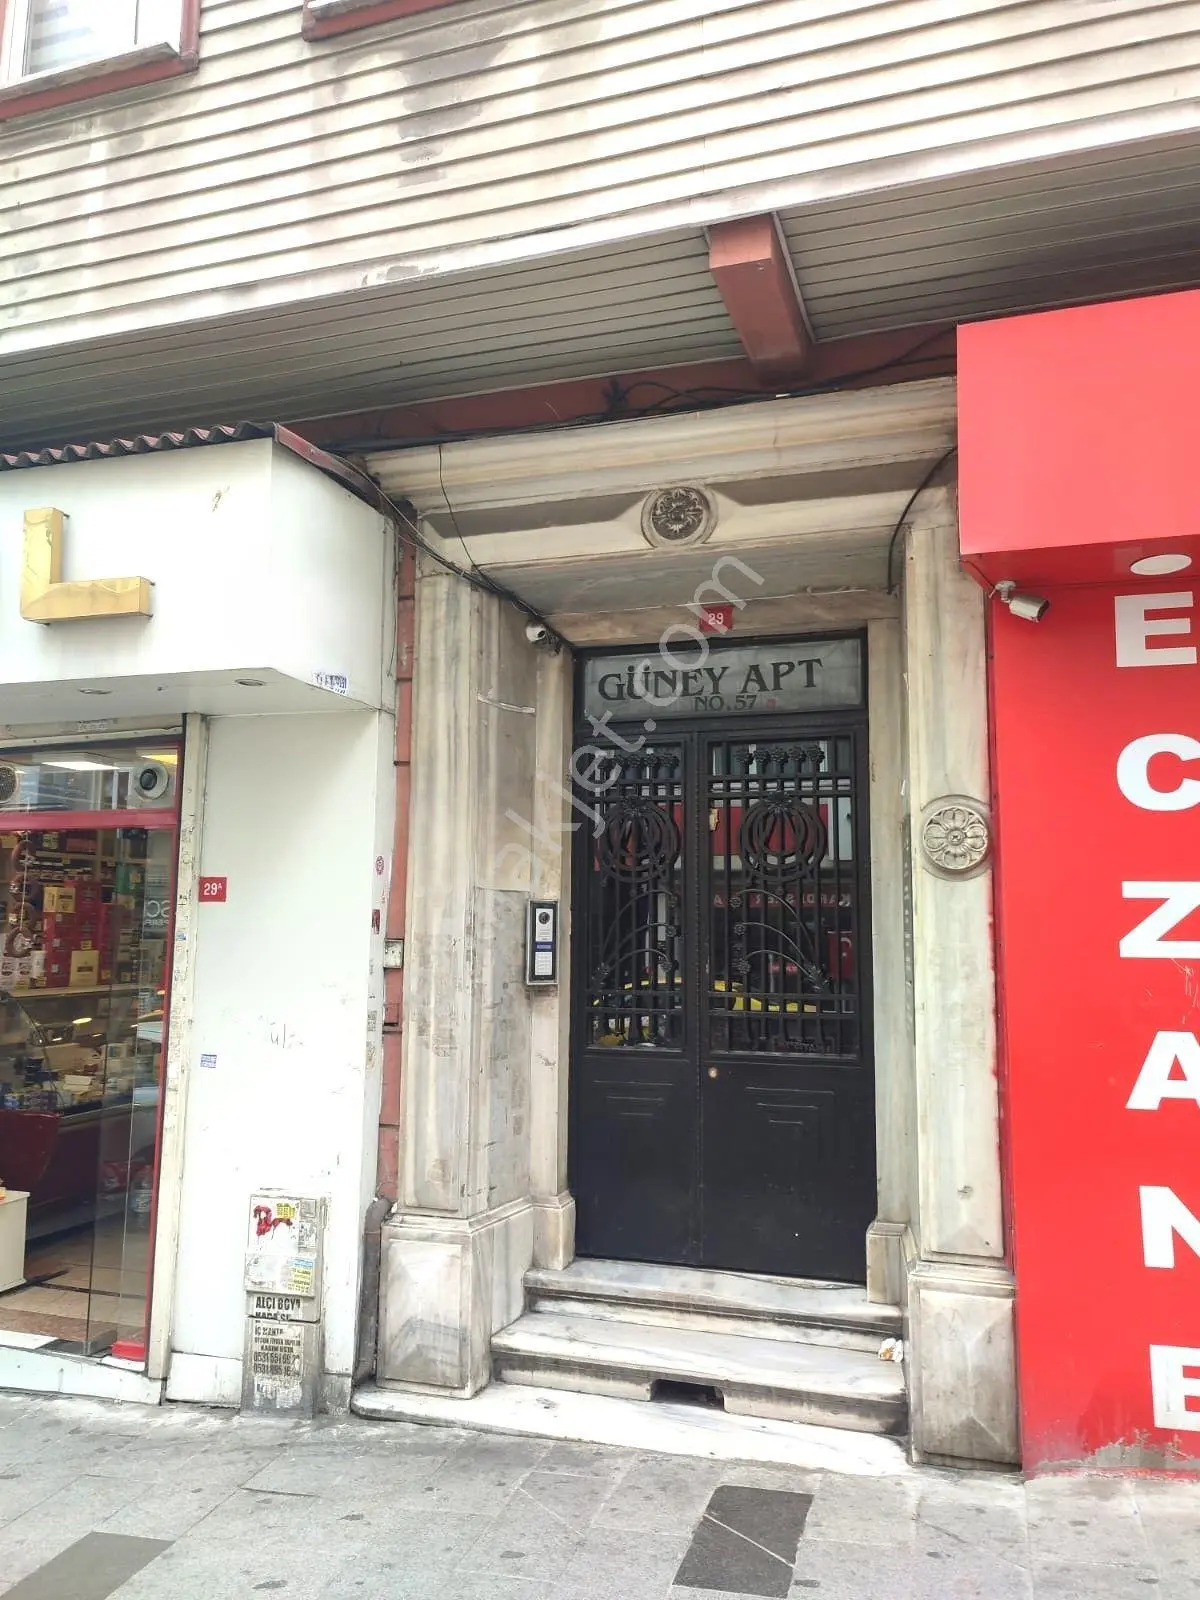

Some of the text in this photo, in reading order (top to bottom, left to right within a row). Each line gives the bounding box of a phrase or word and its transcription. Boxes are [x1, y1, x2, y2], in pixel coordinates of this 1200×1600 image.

[20, 507, 154, 625] L
[708, 612, 724, 625] 29
[598, 658, 823, 701] GÜNEY APT
